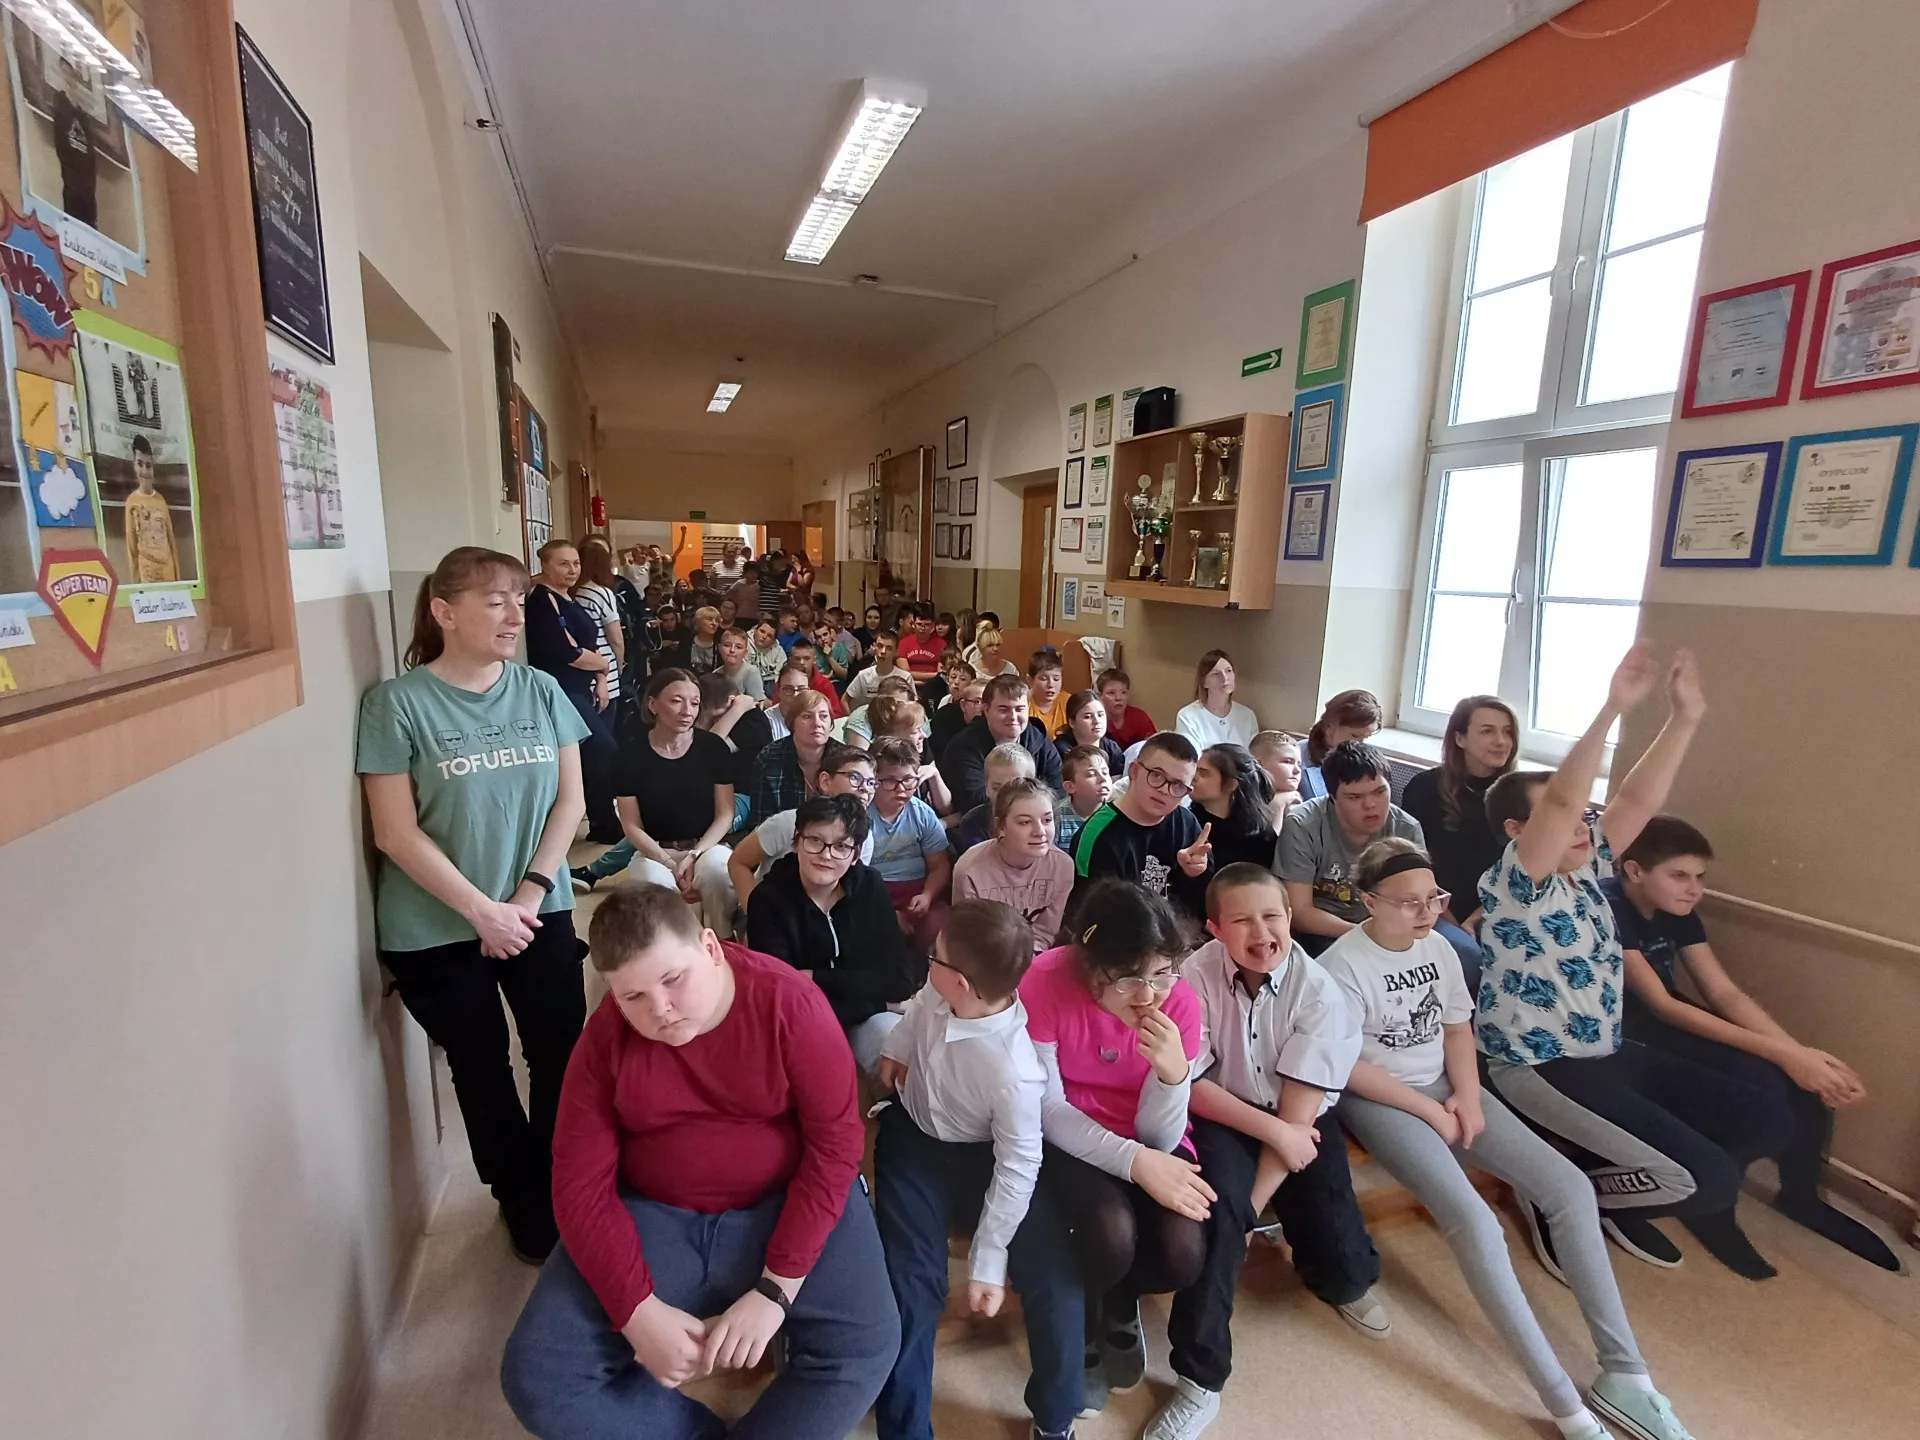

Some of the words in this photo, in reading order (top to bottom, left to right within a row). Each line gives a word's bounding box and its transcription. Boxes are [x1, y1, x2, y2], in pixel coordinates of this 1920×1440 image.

[54, 576, 82, 601] SUPER
[81, 575, 107, 595] TEAM
[437, 745, 555, 780] TOFUELLED
[1383, 962, 1440, 992] BAMBI
